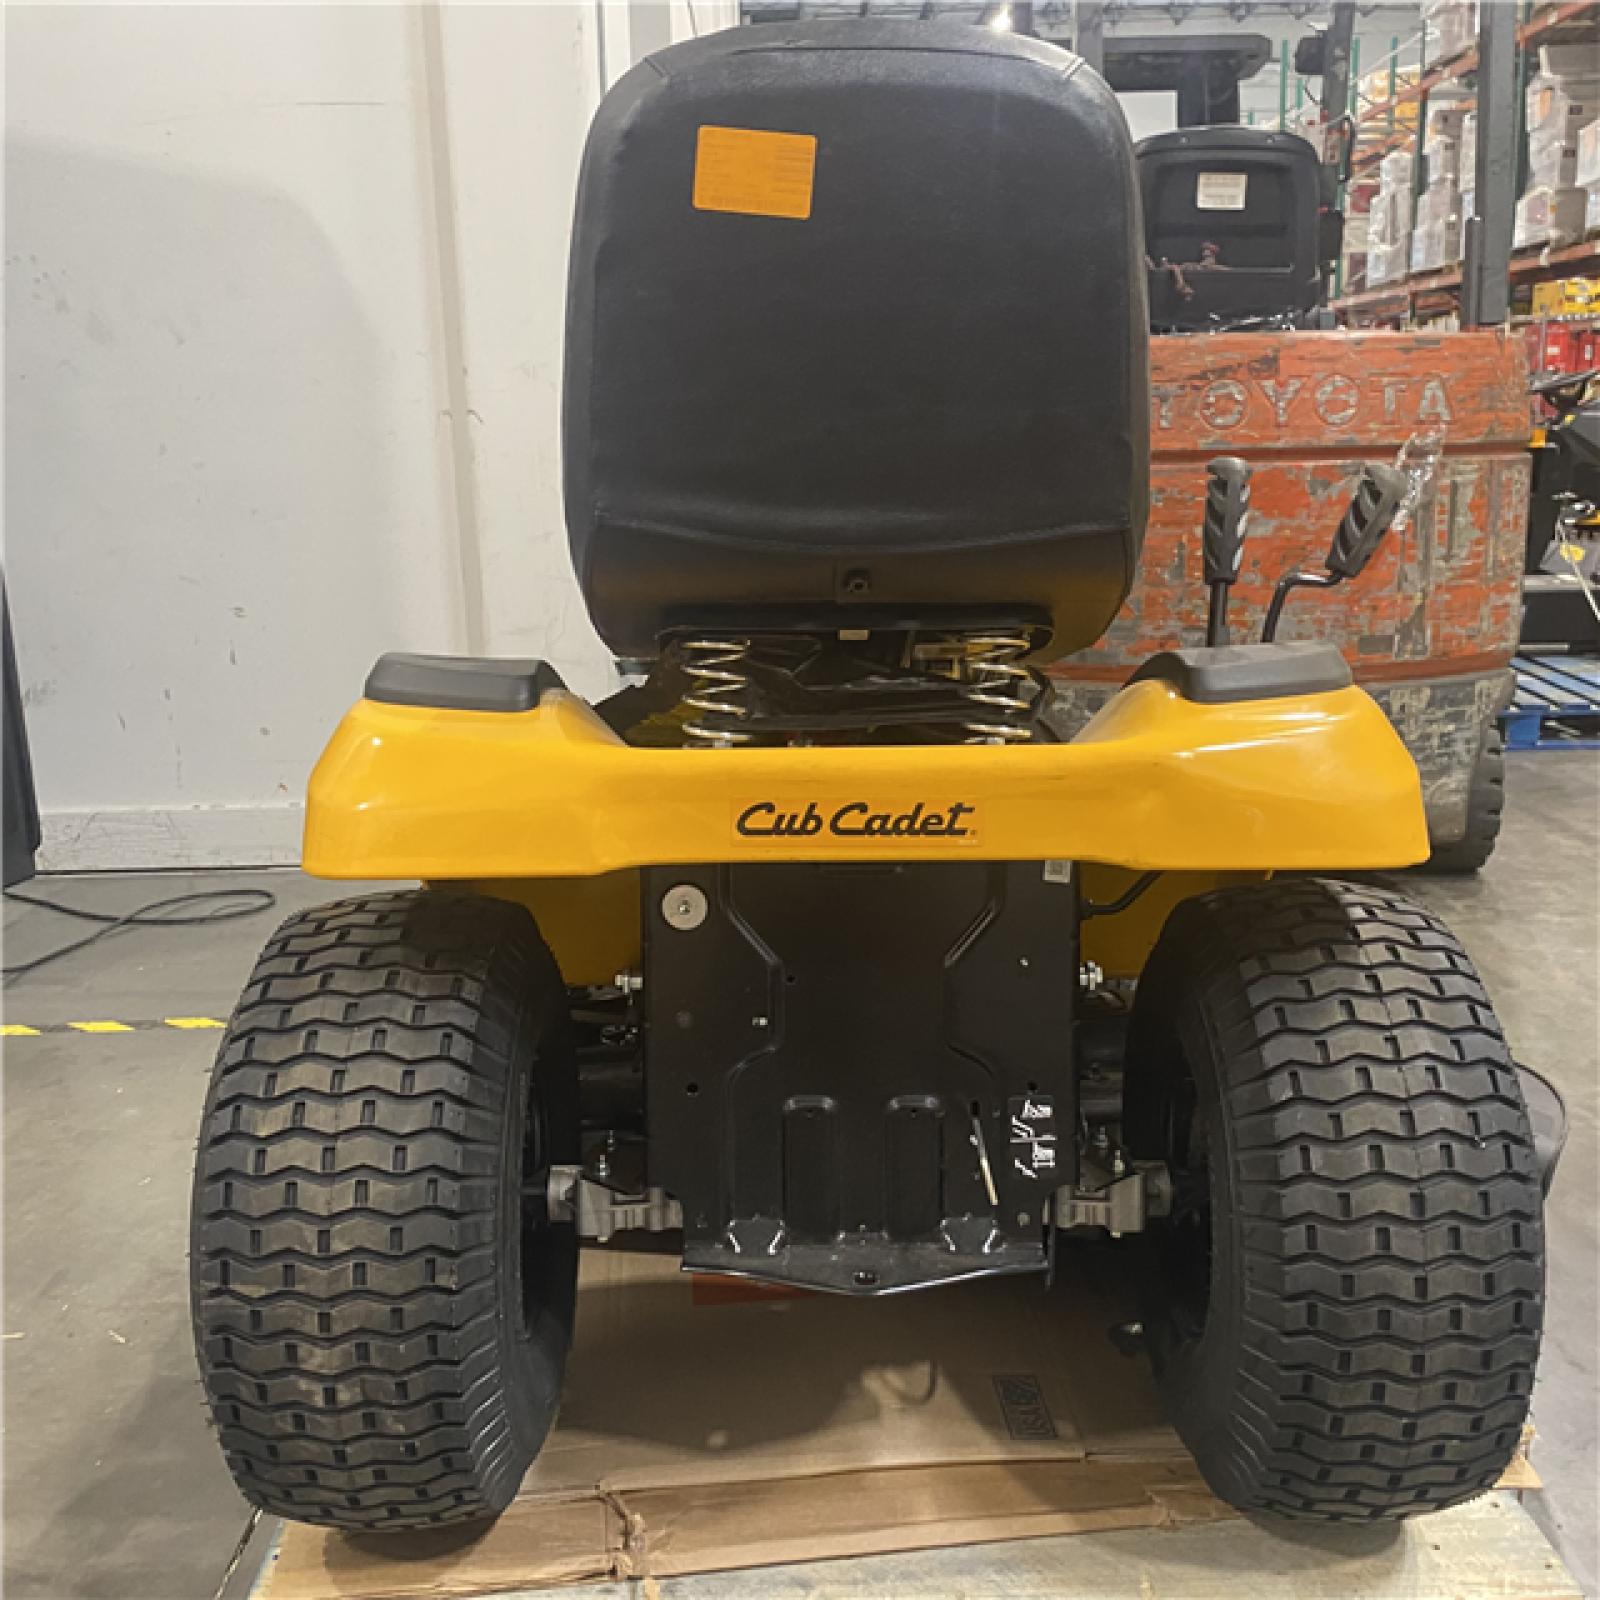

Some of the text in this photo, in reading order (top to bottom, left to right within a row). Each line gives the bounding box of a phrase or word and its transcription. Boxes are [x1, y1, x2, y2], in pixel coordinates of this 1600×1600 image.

[1150, 374, 1452, 429] TOYOTA
[737, 802, 976, 836] Cub Cadet
